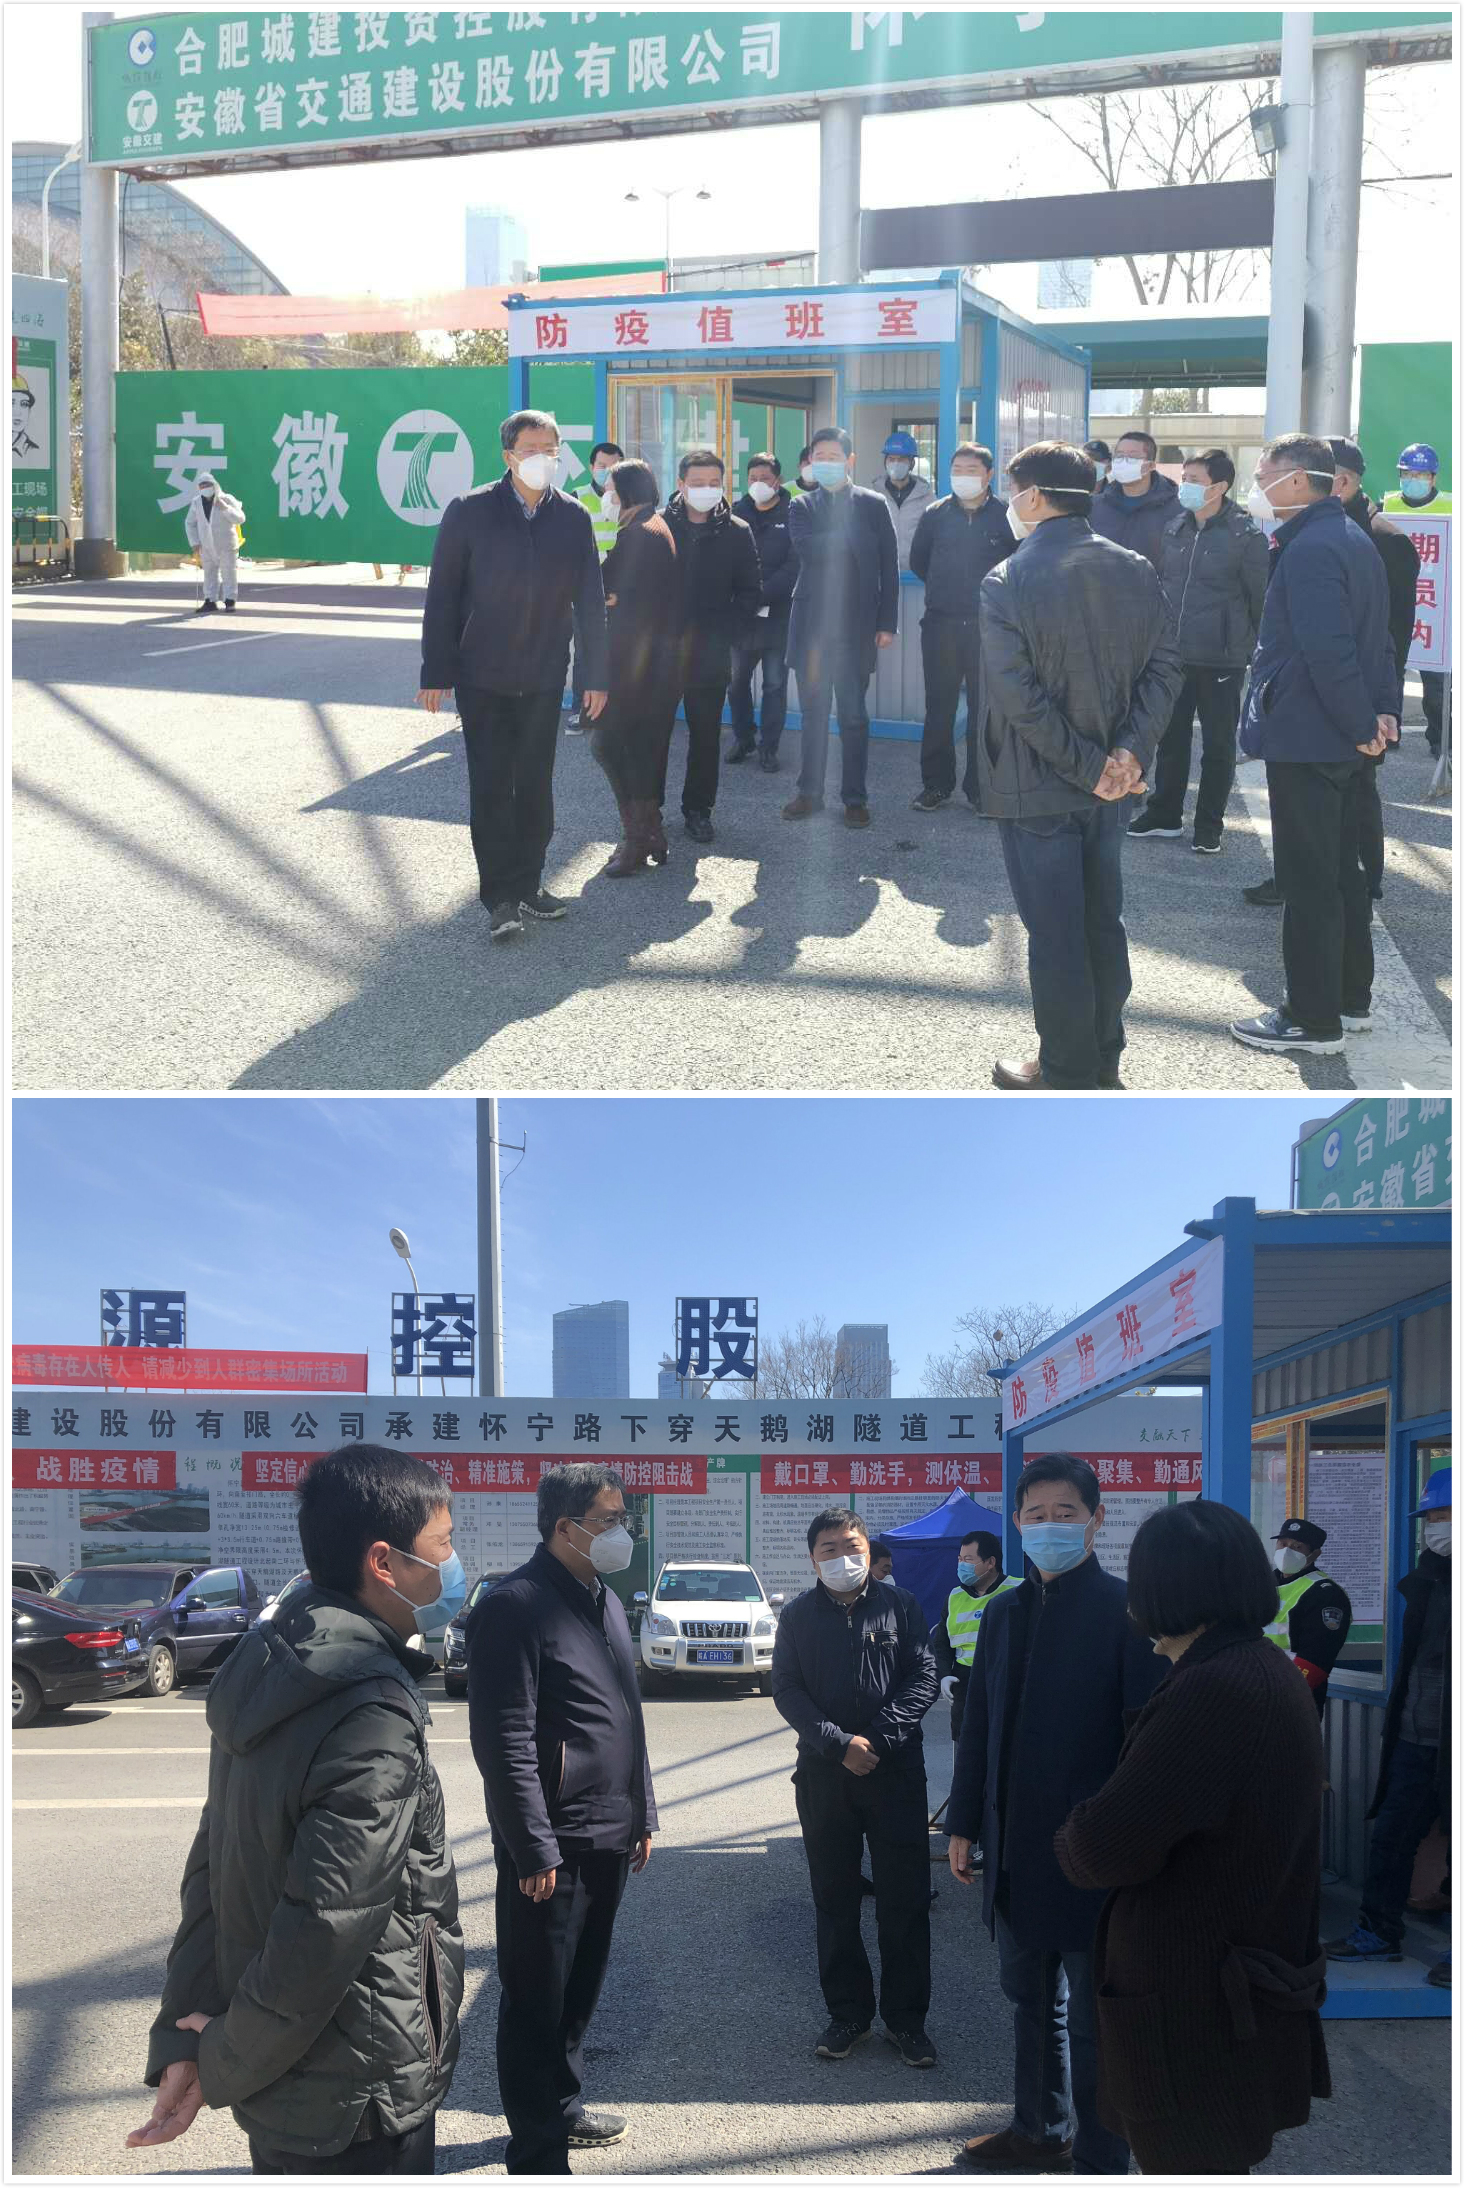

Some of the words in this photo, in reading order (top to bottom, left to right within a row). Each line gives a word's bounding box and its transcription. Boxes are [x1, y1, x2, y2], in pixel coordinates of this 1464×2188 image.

[175, 12, 657, 76] 合肥城建投资控
[175, 22, 781, 141] 安徽省交通建设股份有限公司
[535, 297, 919, 350] 防疫值班室
[1353, 1135, 1452, 1208] 安徽省
[12, 1353, 131, 1380] 病毒存在人传人
[142, 1355, 348, 1384] 请减少到人群密集场所活动
[102, 1290, 186, 1347] 源
[391, 1293, 477, 1376] 控
[676, 1297, 757, 1379] 股
[1011, 1269, 1197, 1421] 防疫值班室
[36, 1456, 160, 1484] 战胜疫情
